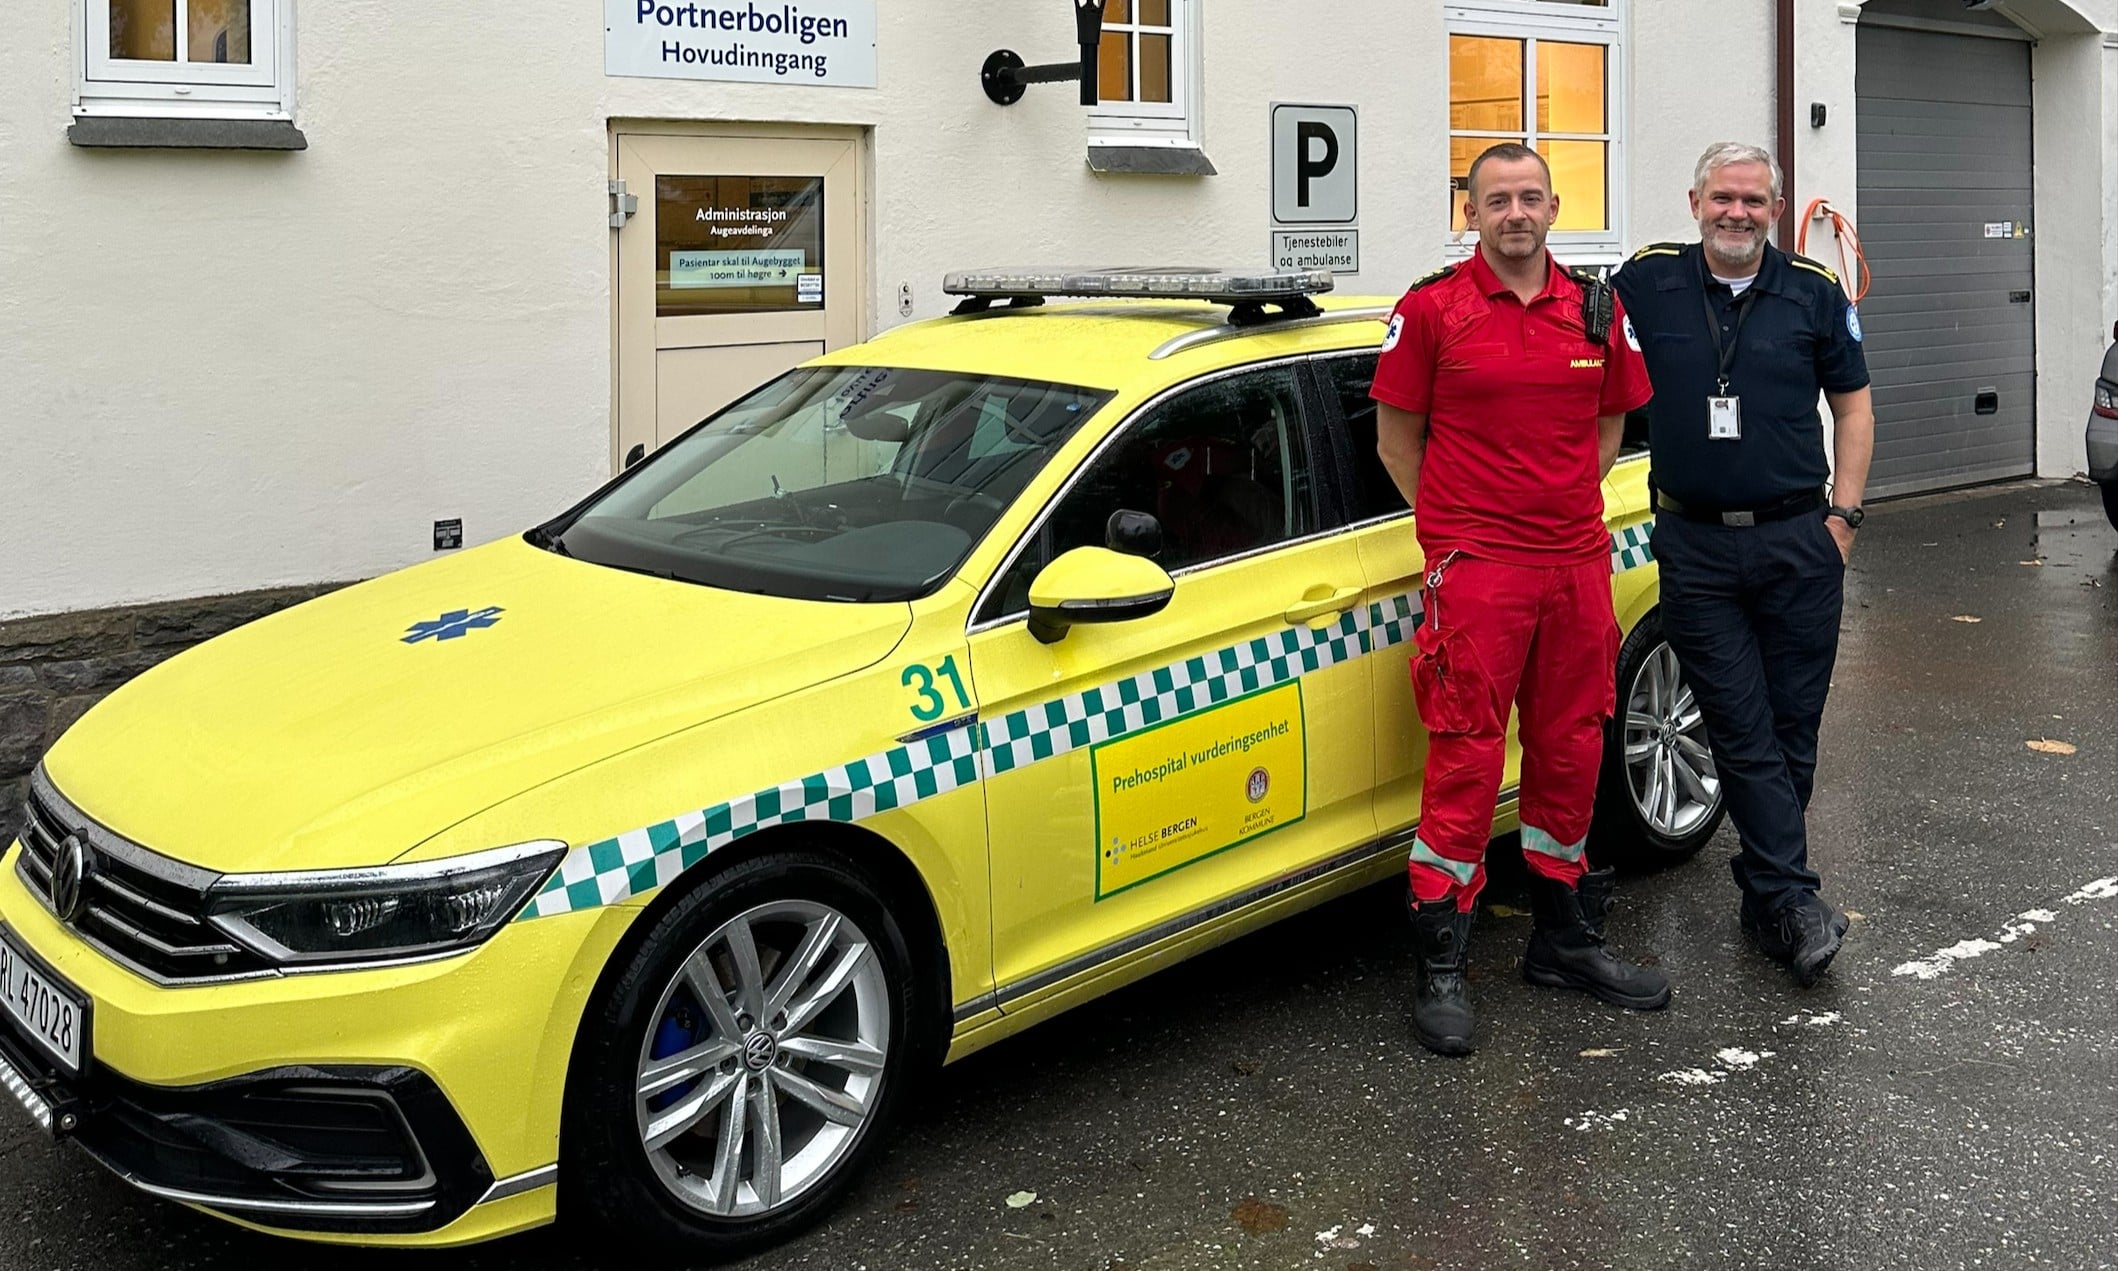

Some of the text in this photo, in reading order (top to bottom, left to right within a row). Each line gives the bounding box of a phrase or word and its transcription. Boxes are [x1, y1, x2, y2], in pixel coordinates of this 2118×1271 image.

[637, 0, 848, 44] Portnerboligen
[662, 41, 827, 77] Hovudinngang
[1297, 121, 1339, 208] P
[696, 207, 787, 223] Administrasjon
[710, 225, 773, 237] Augeavdelinga
[1283, 235, 1348, 251] Tjenestebiler
[679, 255, 801, 268] Pasientar skal til Augebygget
[1280, 254, 1352, 267] og ambulanse
[710, 270, 771, 281] 100m til høgre
[901, 654, 972, 721] 31
[1113, 719, 1289, 793] Prehospital vurderingsenhet
[1239, 815, 1274, 836] KOMMUNE
[1244, 807, 1271, 823] BERGEN
[1130, 816, 1198, 850] HELSE BERGEN
[0, 946, 73, 1053] RL 47028
